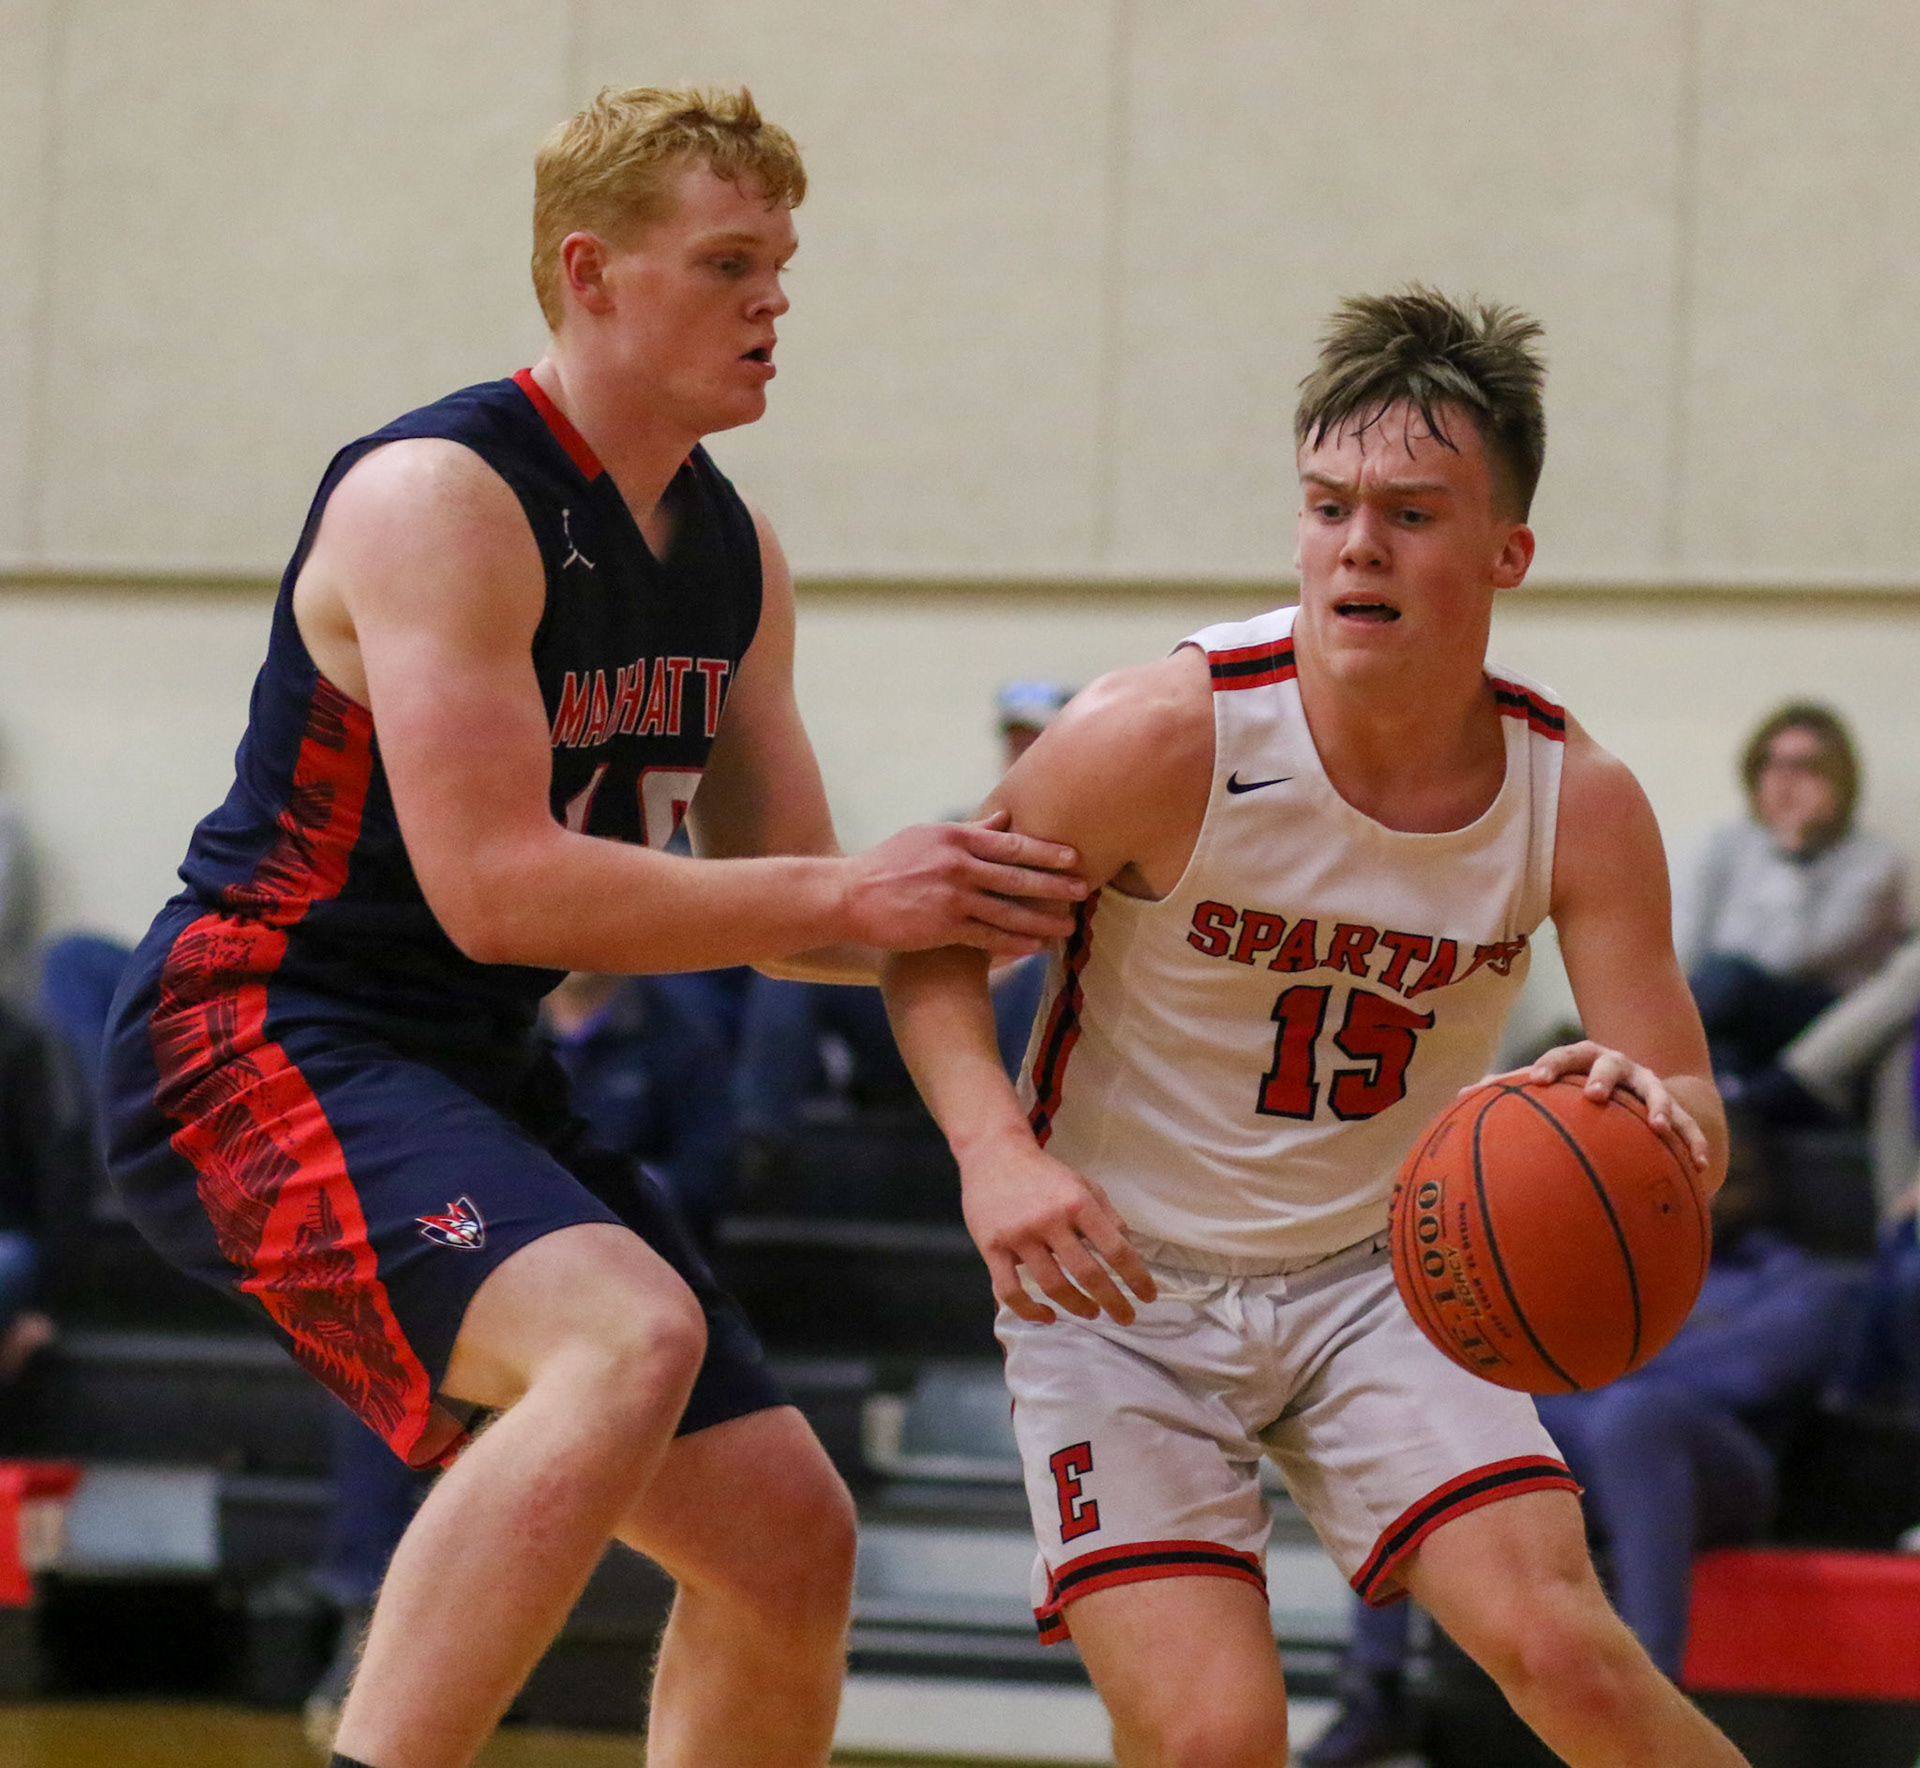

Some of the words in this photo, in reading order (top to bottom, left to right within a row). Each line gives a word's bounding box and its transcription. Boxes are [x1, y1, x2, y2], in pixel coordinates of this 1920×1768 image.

[551, 656, 735, 748] MAHATT
[1255, 984, 1435, 1121] 15
[1049, 1440, 1101, 1545] E
